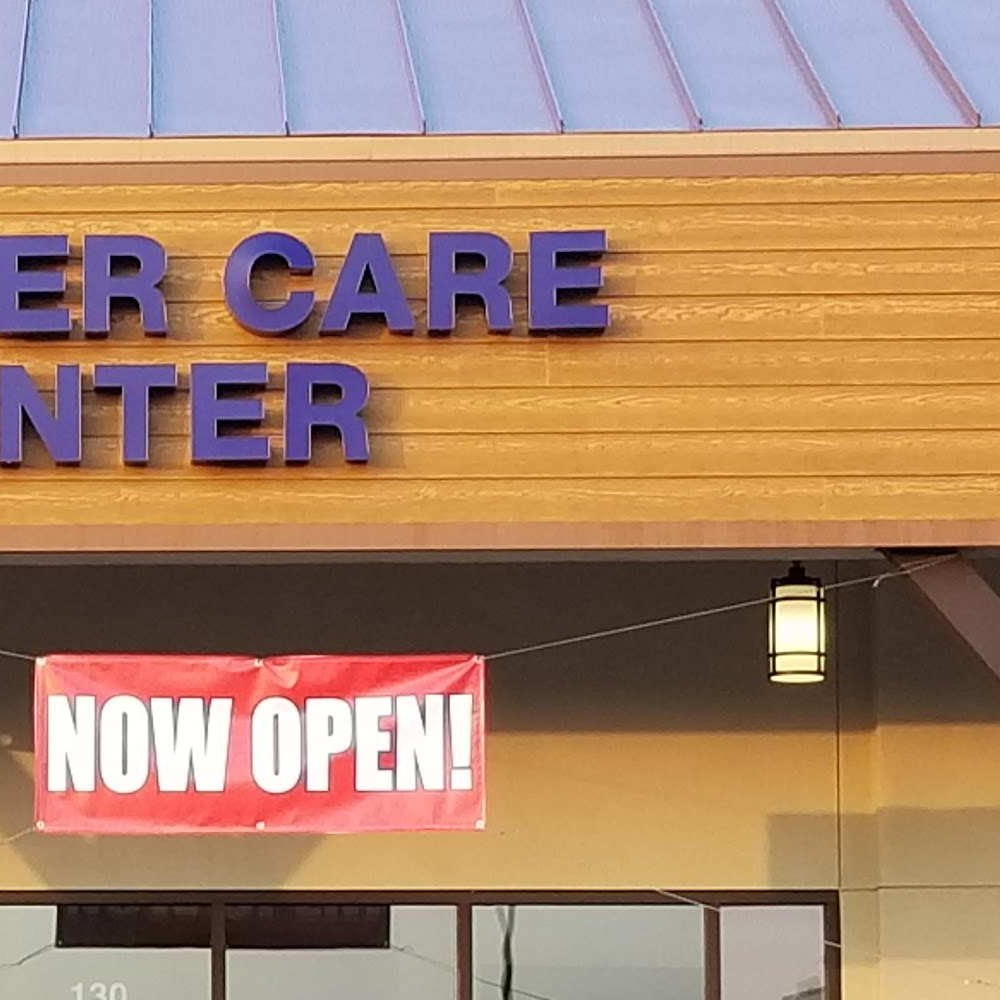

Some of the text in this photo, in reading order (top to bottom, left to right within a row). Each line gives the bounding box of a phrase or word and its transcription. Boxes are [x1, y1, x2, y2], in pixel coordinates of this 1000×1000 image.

[222, 229, 611, 338] CARE
[47, 692, 474, 795] NOW OPEN!
